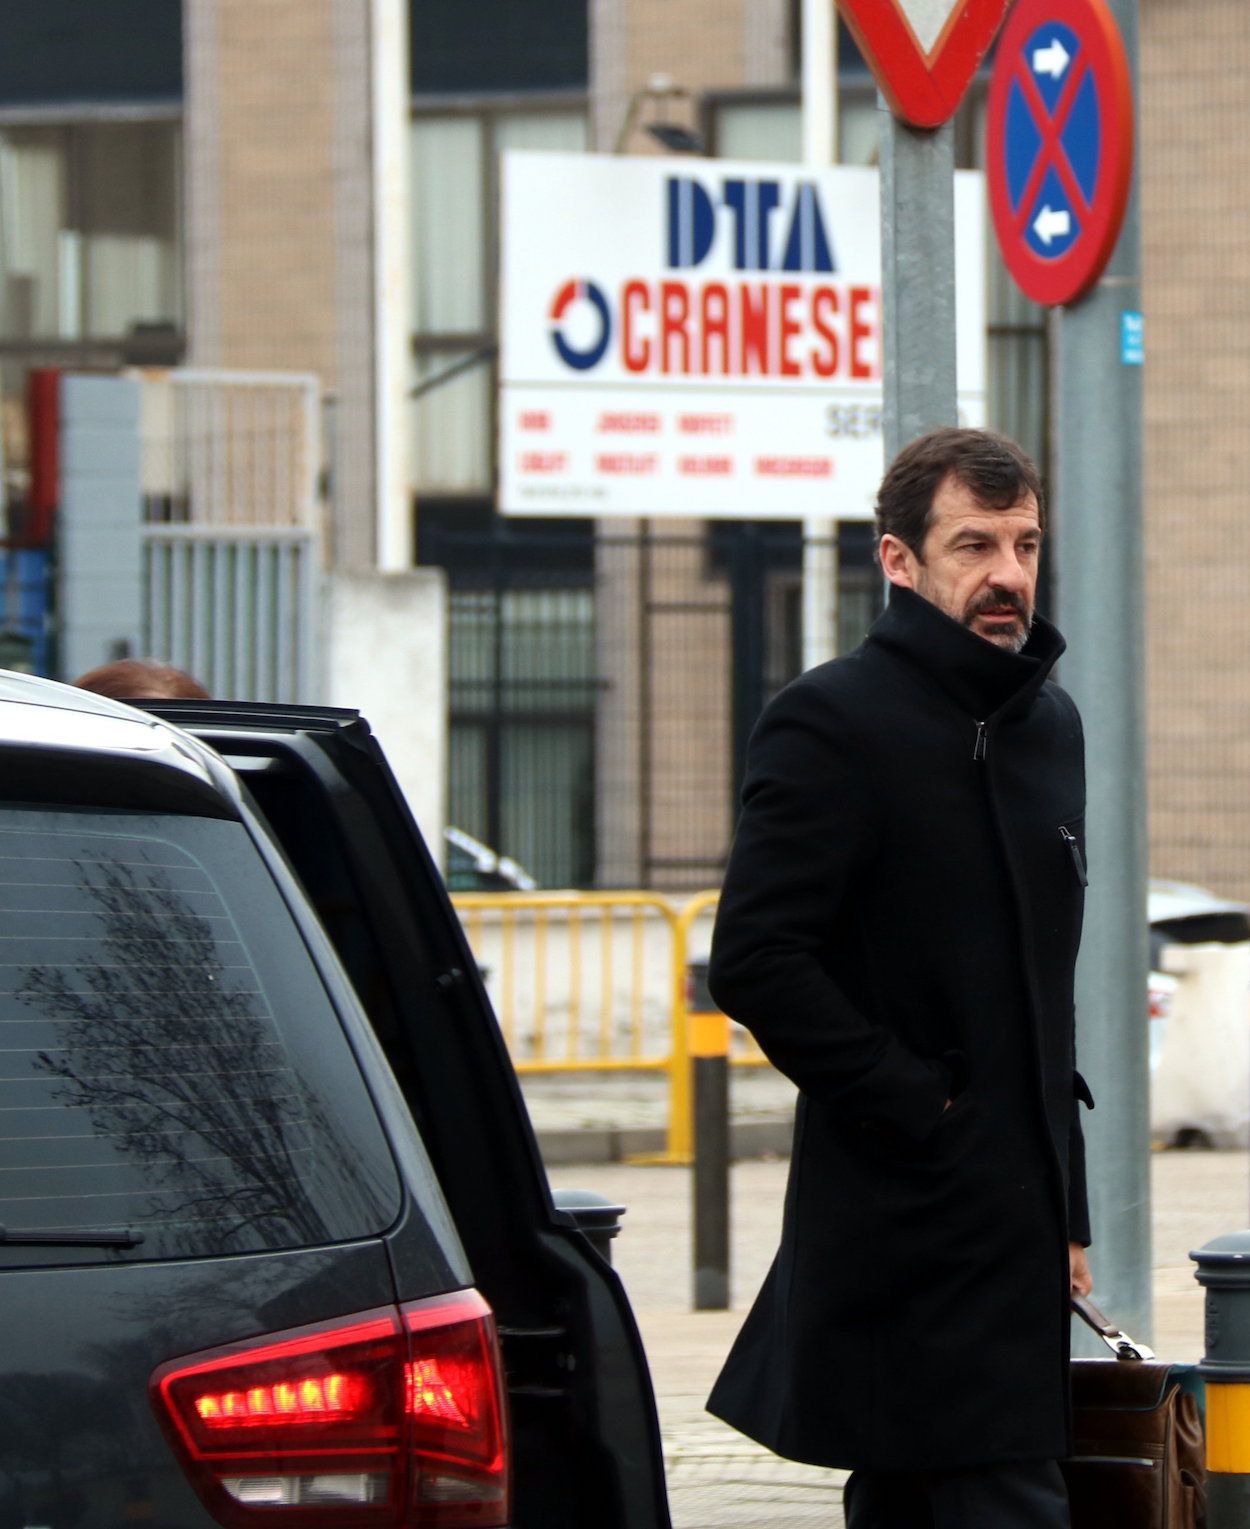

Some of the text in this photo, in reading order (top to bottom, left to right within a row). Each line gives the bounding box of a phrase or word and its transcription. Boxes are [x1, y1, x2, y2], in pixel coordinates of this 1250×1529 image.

[666, 176, 836, 273] DTA
[620, 279, 882, 379] CRANESE
[826, 404, 883, 437] SER
